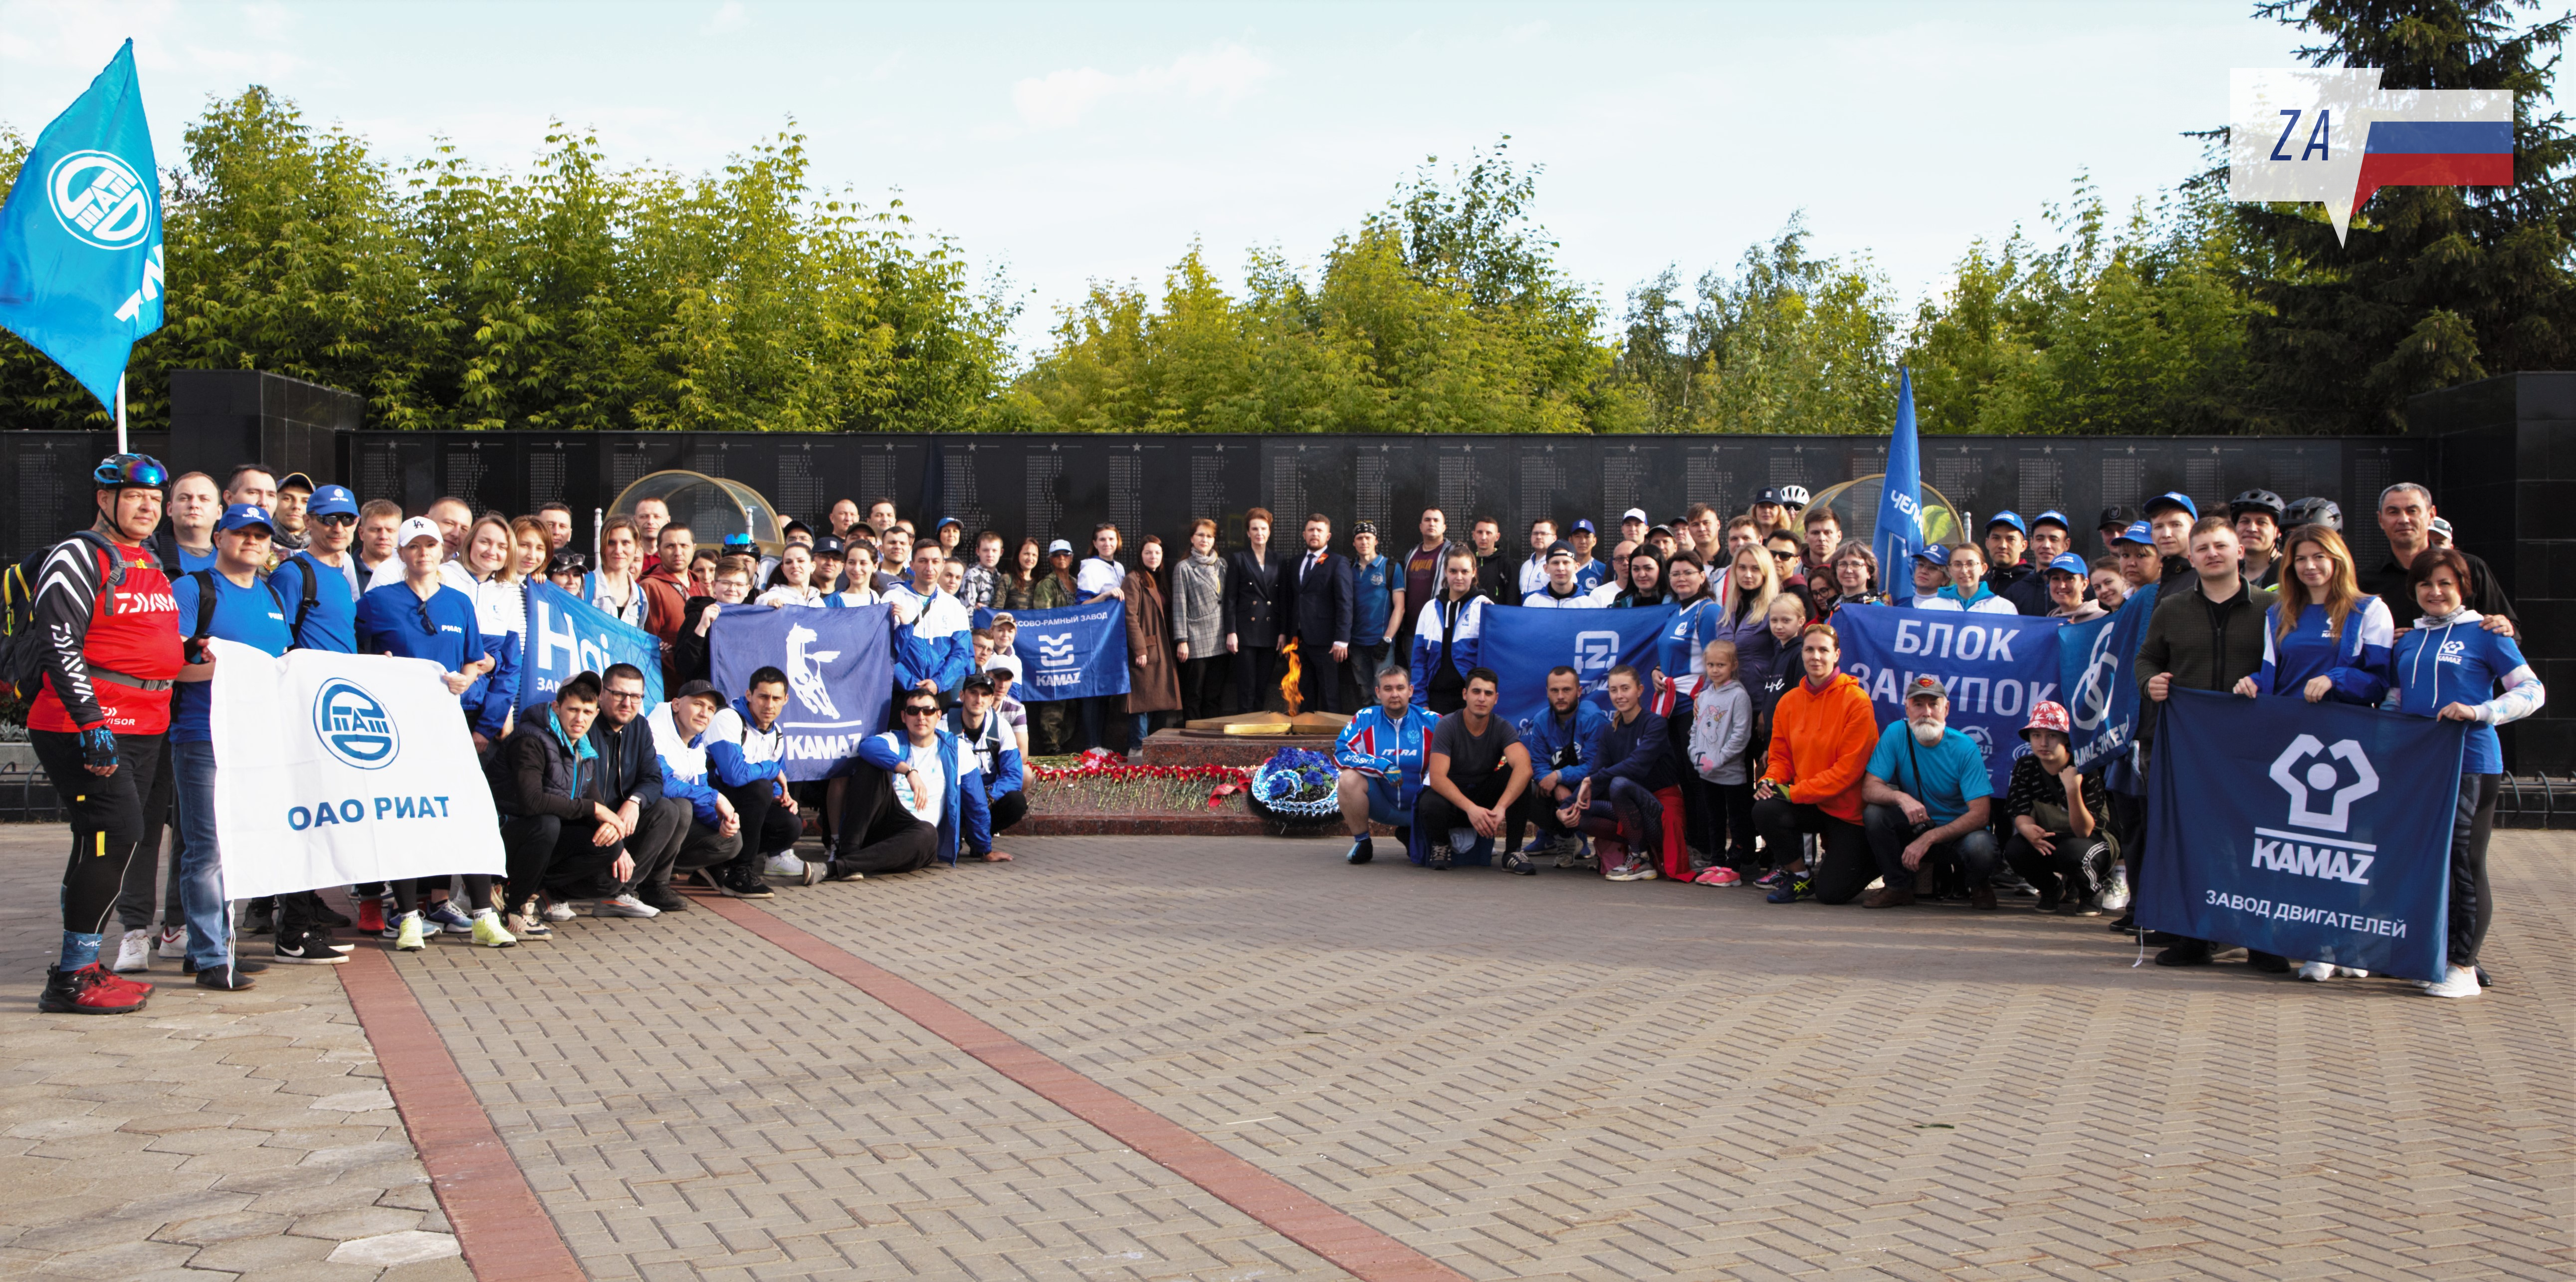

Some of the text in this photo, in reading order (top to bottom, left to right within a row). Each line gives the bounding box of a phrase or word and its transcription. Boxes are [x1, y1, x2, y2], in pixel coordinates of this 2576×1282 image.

[441, 624, 462, 634] РИАТ
[1080, 612, 1108, 622] ЗАВОД
[1894, 619, 2020, 662] БЛОК
[2438, 655, 2462, 665] KAMAZ
[1036, 672, 1081, 687] KAMAZ
[786, 733, 862, 761] KAMAZ
[288, 796, 449, 831] ОАО РИАТ
[2251, 837, 2374, 885] KAMAZ
[2205, 890, 2407, 939] ЗАВОД ДВИГАТЕЛЕЙ
